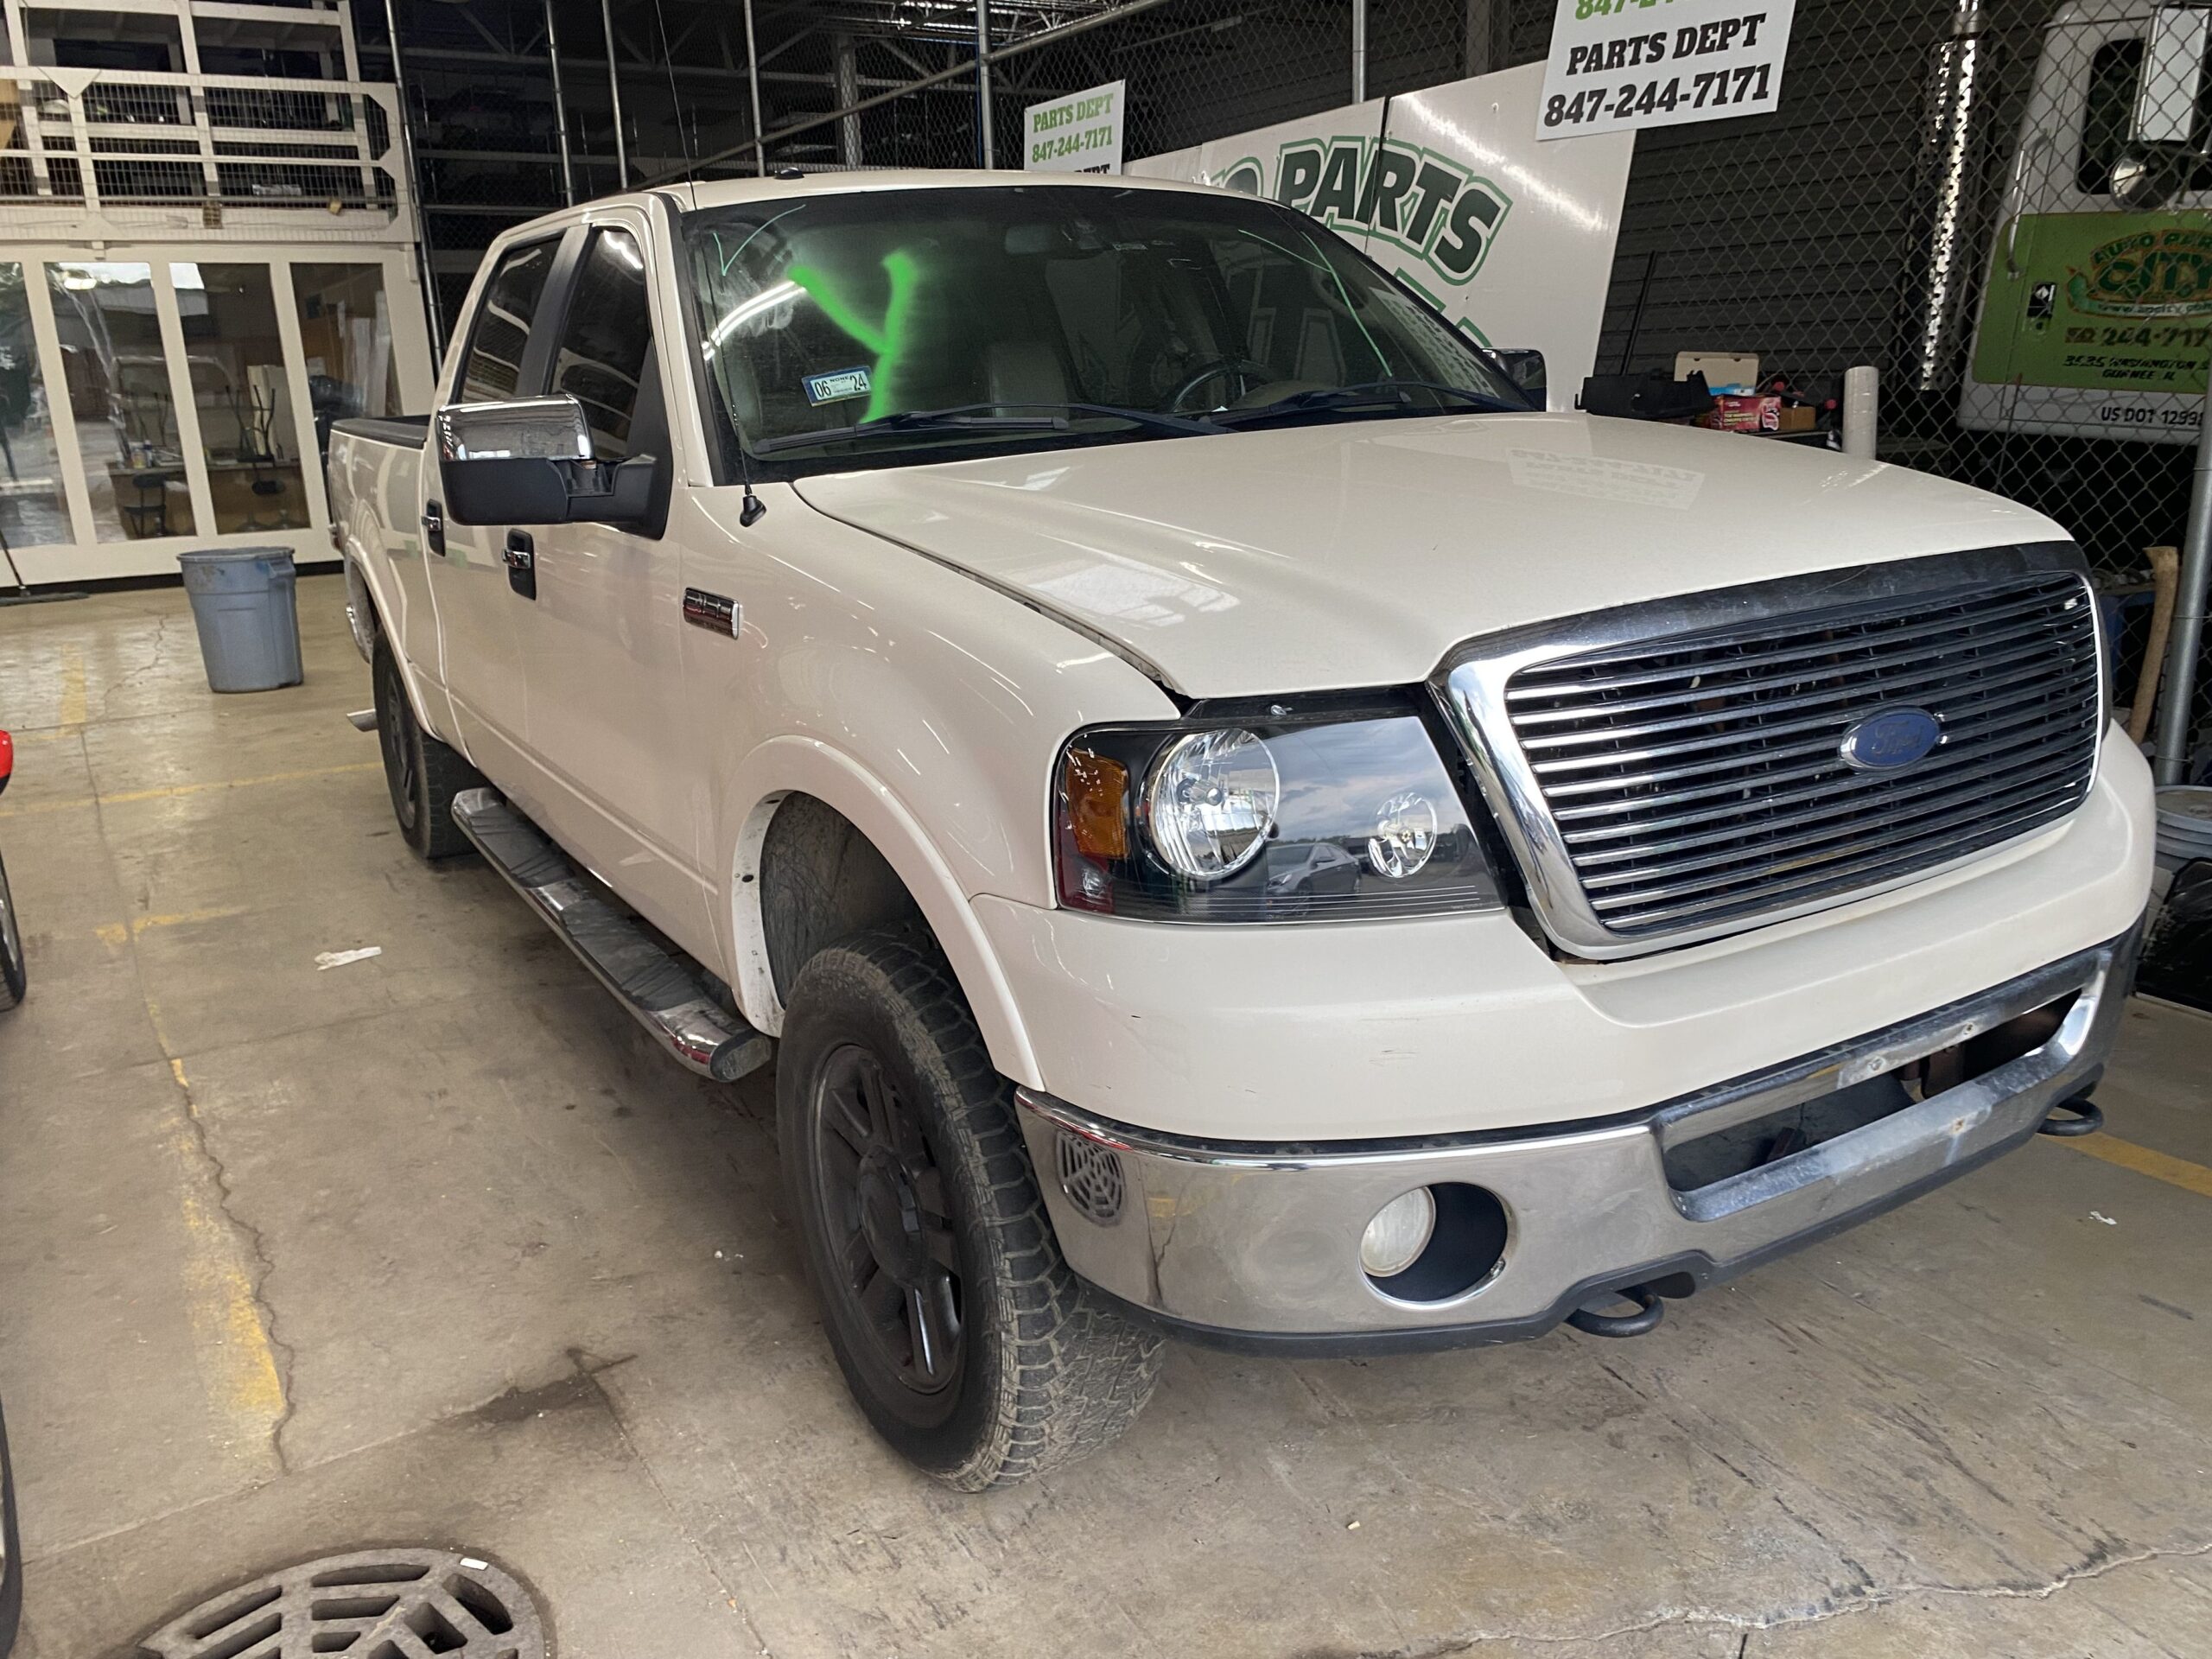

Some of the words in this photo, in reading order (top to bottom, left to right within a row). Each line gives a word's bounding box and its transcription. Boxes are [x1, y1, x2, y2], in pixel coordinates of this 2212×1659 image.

[1566, 32, 1667, 76] PARTS
[1672, 13, 1767, 59] DEPT
[1033, 105, 1074, 133] PARTS
[1076, 92, 1114, 121] DEPT
[1543, 63, 1771, 127] 847-244-7171
[1032, 124, 1113, 163] 847-244-7171
[1275, 143, 1505, 276] PARTS
[2101, 407, 2121, 422] US
[2124, 408, 2155, 423] DOT
